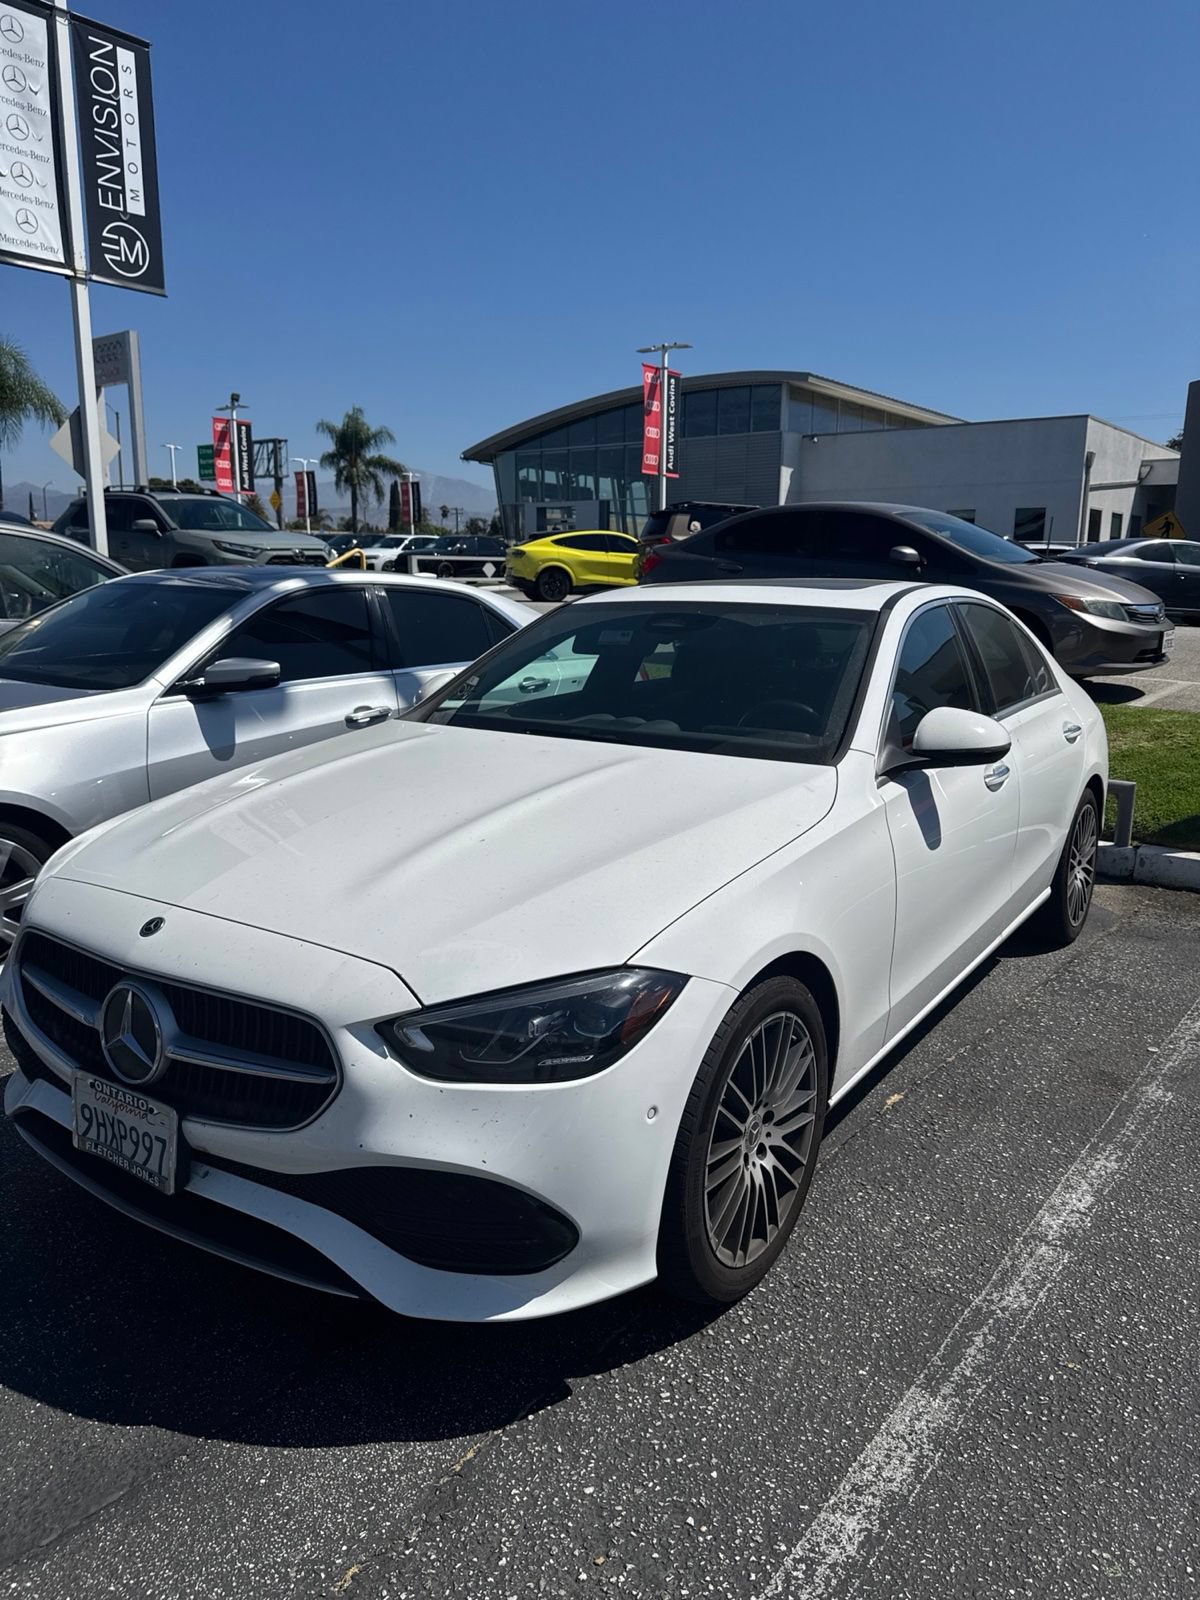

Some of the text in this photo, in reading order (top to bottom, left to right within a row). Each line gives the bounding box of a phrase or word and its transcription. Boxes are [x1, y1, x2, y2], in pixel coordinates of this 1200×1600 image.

[88, 36, 123, 211] ENVISION
[122, 64, 140, 202] MOTORS
[0, 186, 56, 210] ercedes-Benz
[668, 378, 676, 414] Covina
[94, 1080, 147, 1110] ONTARIO
[80, 1103, 167, 1178] 9HXP997
[85, 1141, 130, 1170] FLETCHER
